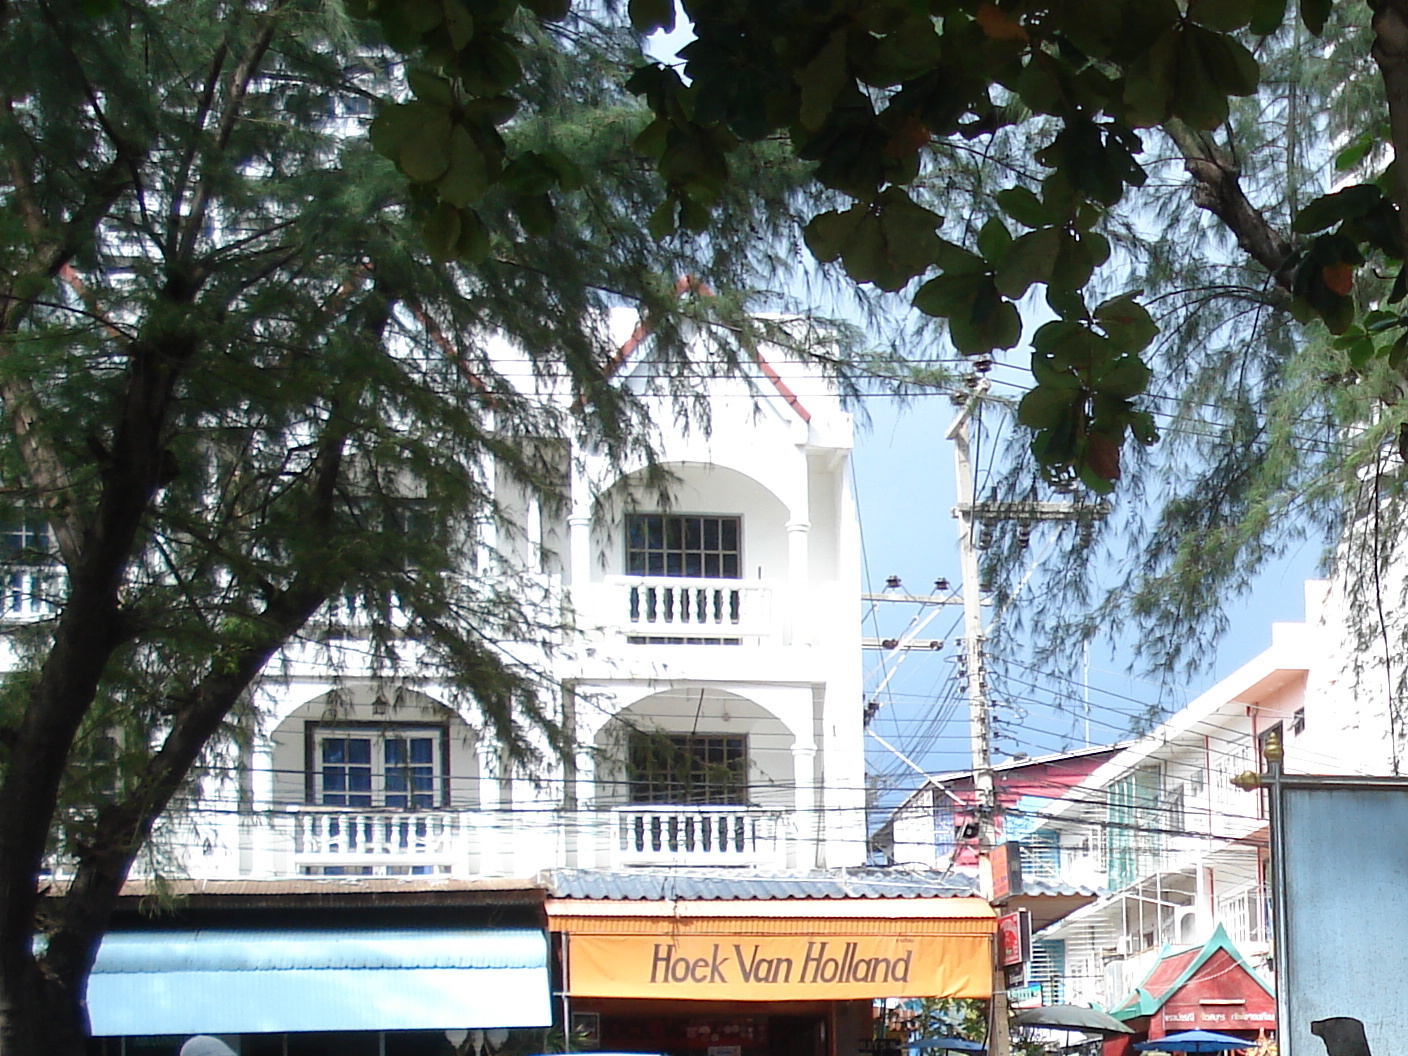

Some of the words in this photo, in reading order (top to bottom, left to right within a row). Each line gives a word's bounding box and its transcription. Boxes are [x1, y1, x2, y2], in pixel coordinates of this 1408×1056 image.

[649, 943, 731, 984] Hoek
[733, 944, 793, 984] Van
[797, 941, 913, 984] Holland
